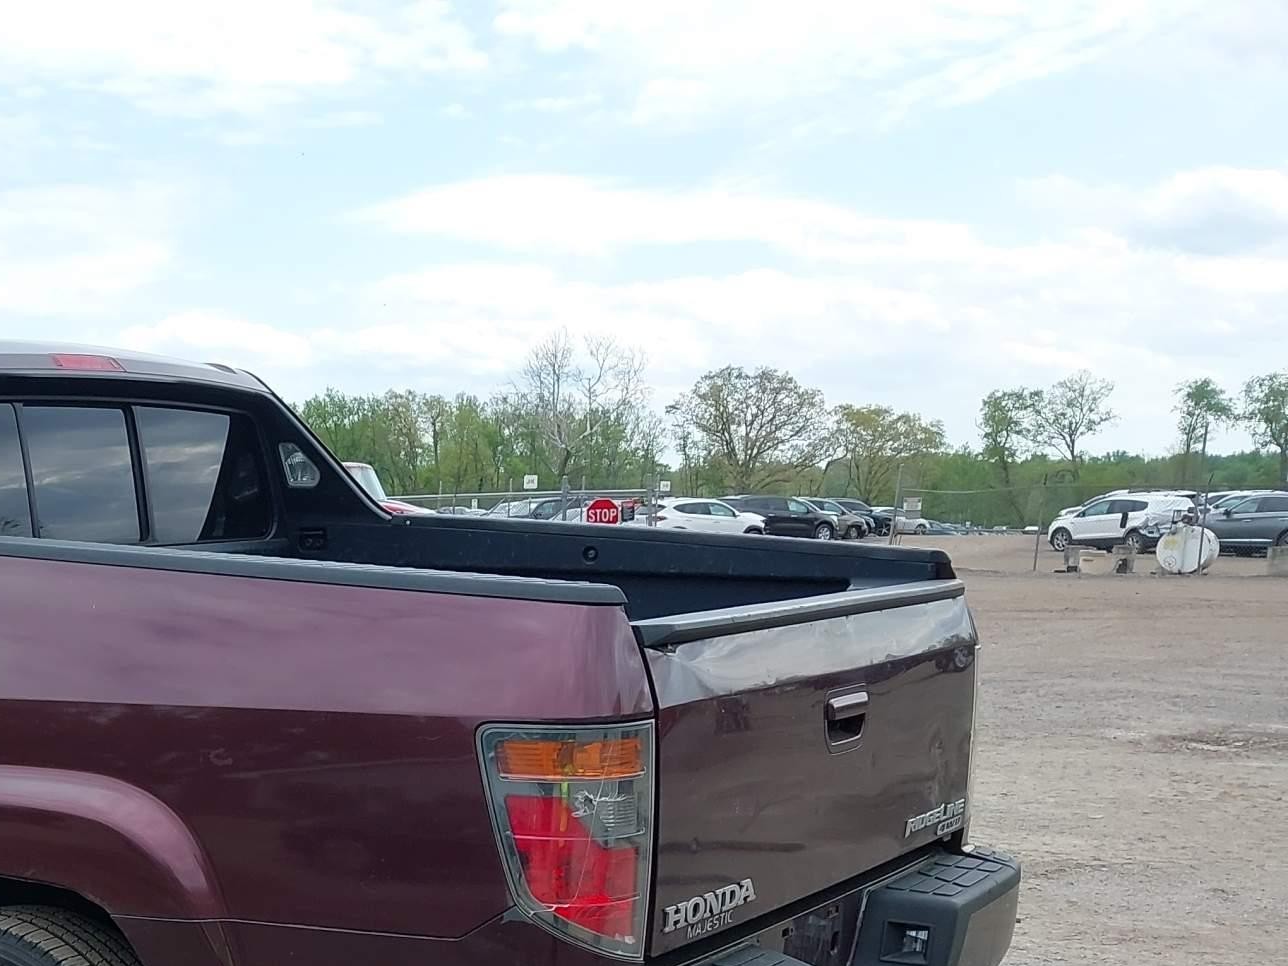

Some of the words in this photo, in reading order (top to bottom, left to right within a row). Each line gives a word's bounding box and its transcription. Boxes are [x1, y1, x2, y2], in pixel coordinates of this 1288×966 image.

[588, 508, 617, 522] STOP
[663, 878, 757, 933] HONDA
[687, 910, 734, 939] MAJESTIC
